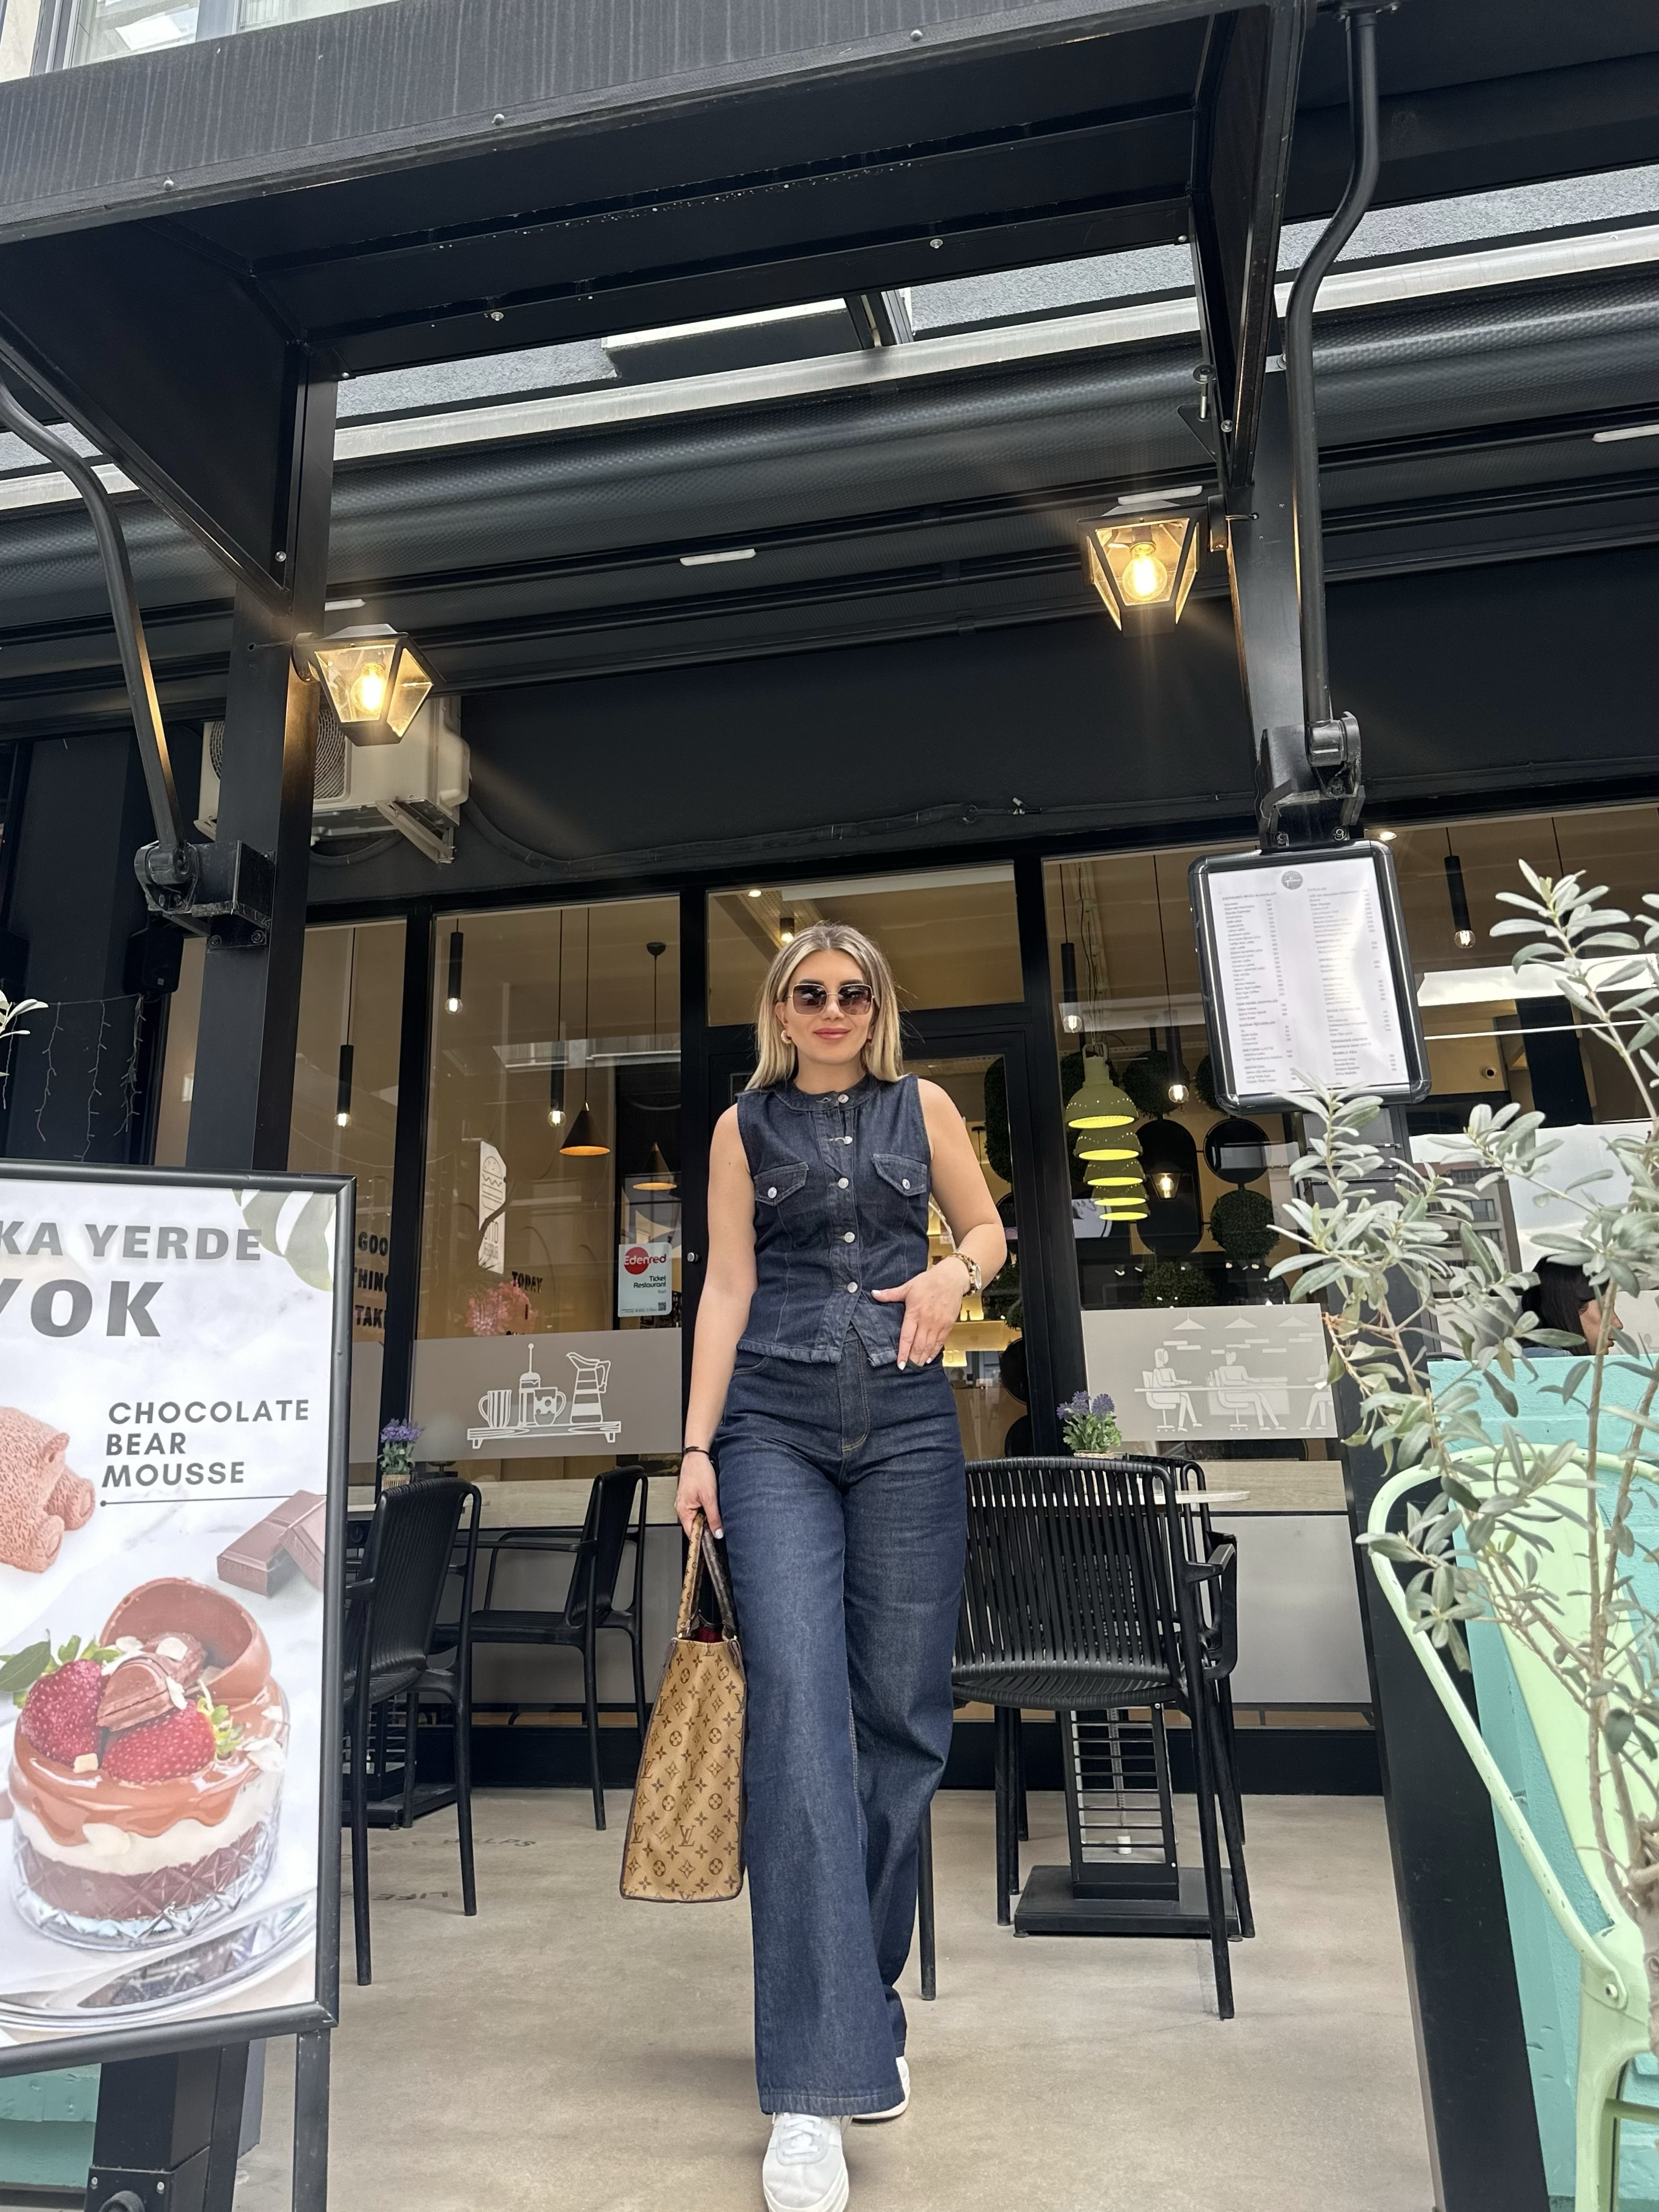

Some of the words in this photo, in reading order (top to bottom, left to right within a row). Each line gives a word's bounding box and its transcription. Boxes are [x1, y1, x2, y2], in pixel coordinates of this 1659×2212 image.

[85, 1224, 262, 1261] YERDE
[624, 1254, 667, 1265] Edenred
[354, 1267, 388, 1293] HIN
[512, 1271, 543, 1294] TODAY
[355, 1305, 386, 1328] TAK
[109, 1399, 309, 1424] CHOCOLATE
[106, 1432, 186, 1455] BEAR
[102, 1461, 244, 1487] MOUSSE
[371, 1891, 448, 1901] LIFE
